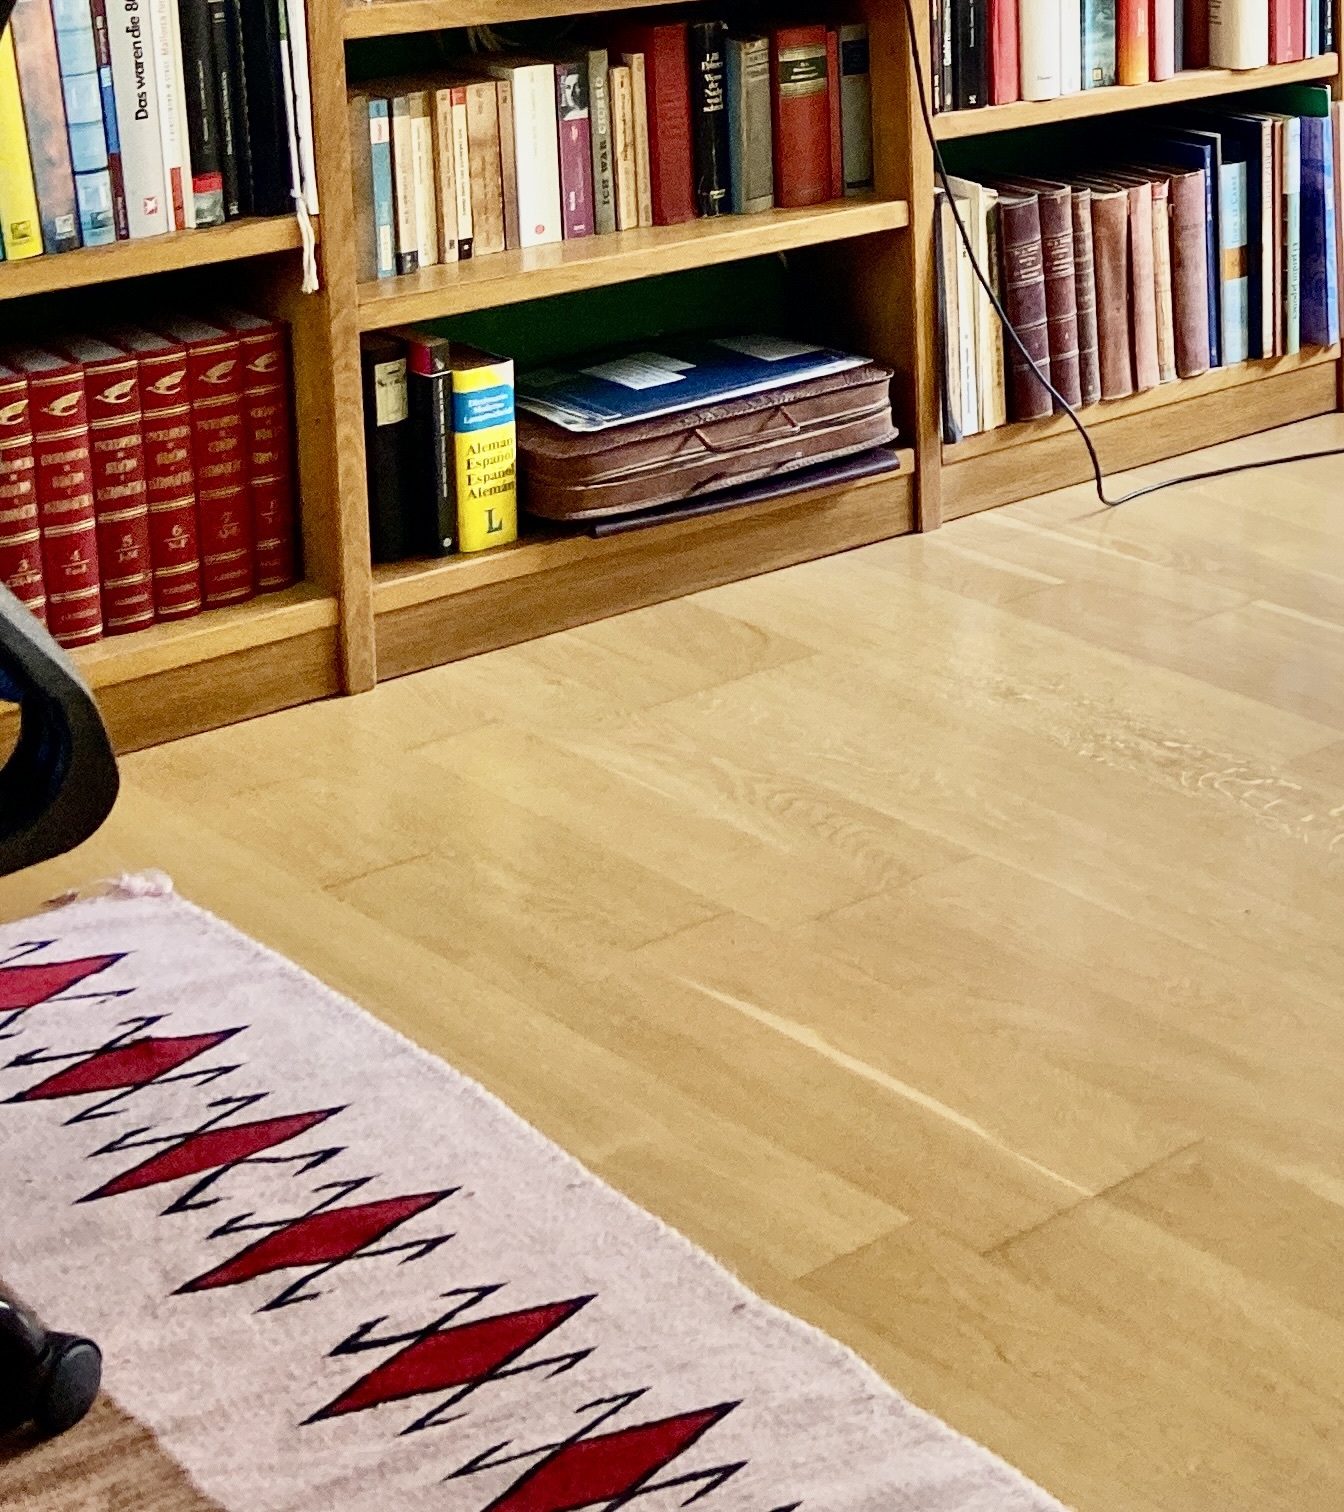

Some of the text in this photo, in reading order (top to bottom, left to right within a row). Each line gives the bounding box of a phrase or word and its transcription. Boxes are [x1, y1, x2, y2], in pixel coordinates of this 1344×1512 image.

[125, 16, 143, 39] die
[131, 40, 147, 90] waren
[133, 92, 149, 121] Das
[598, 139, 609, 173] WAR
[600, 178, 611, 205] ICH
[467, 449, 513, 471] Español
[467, 463, 515, 486] Español
[467, 480, 515, 501] Alemán
[485, 508, 503, 534] L
